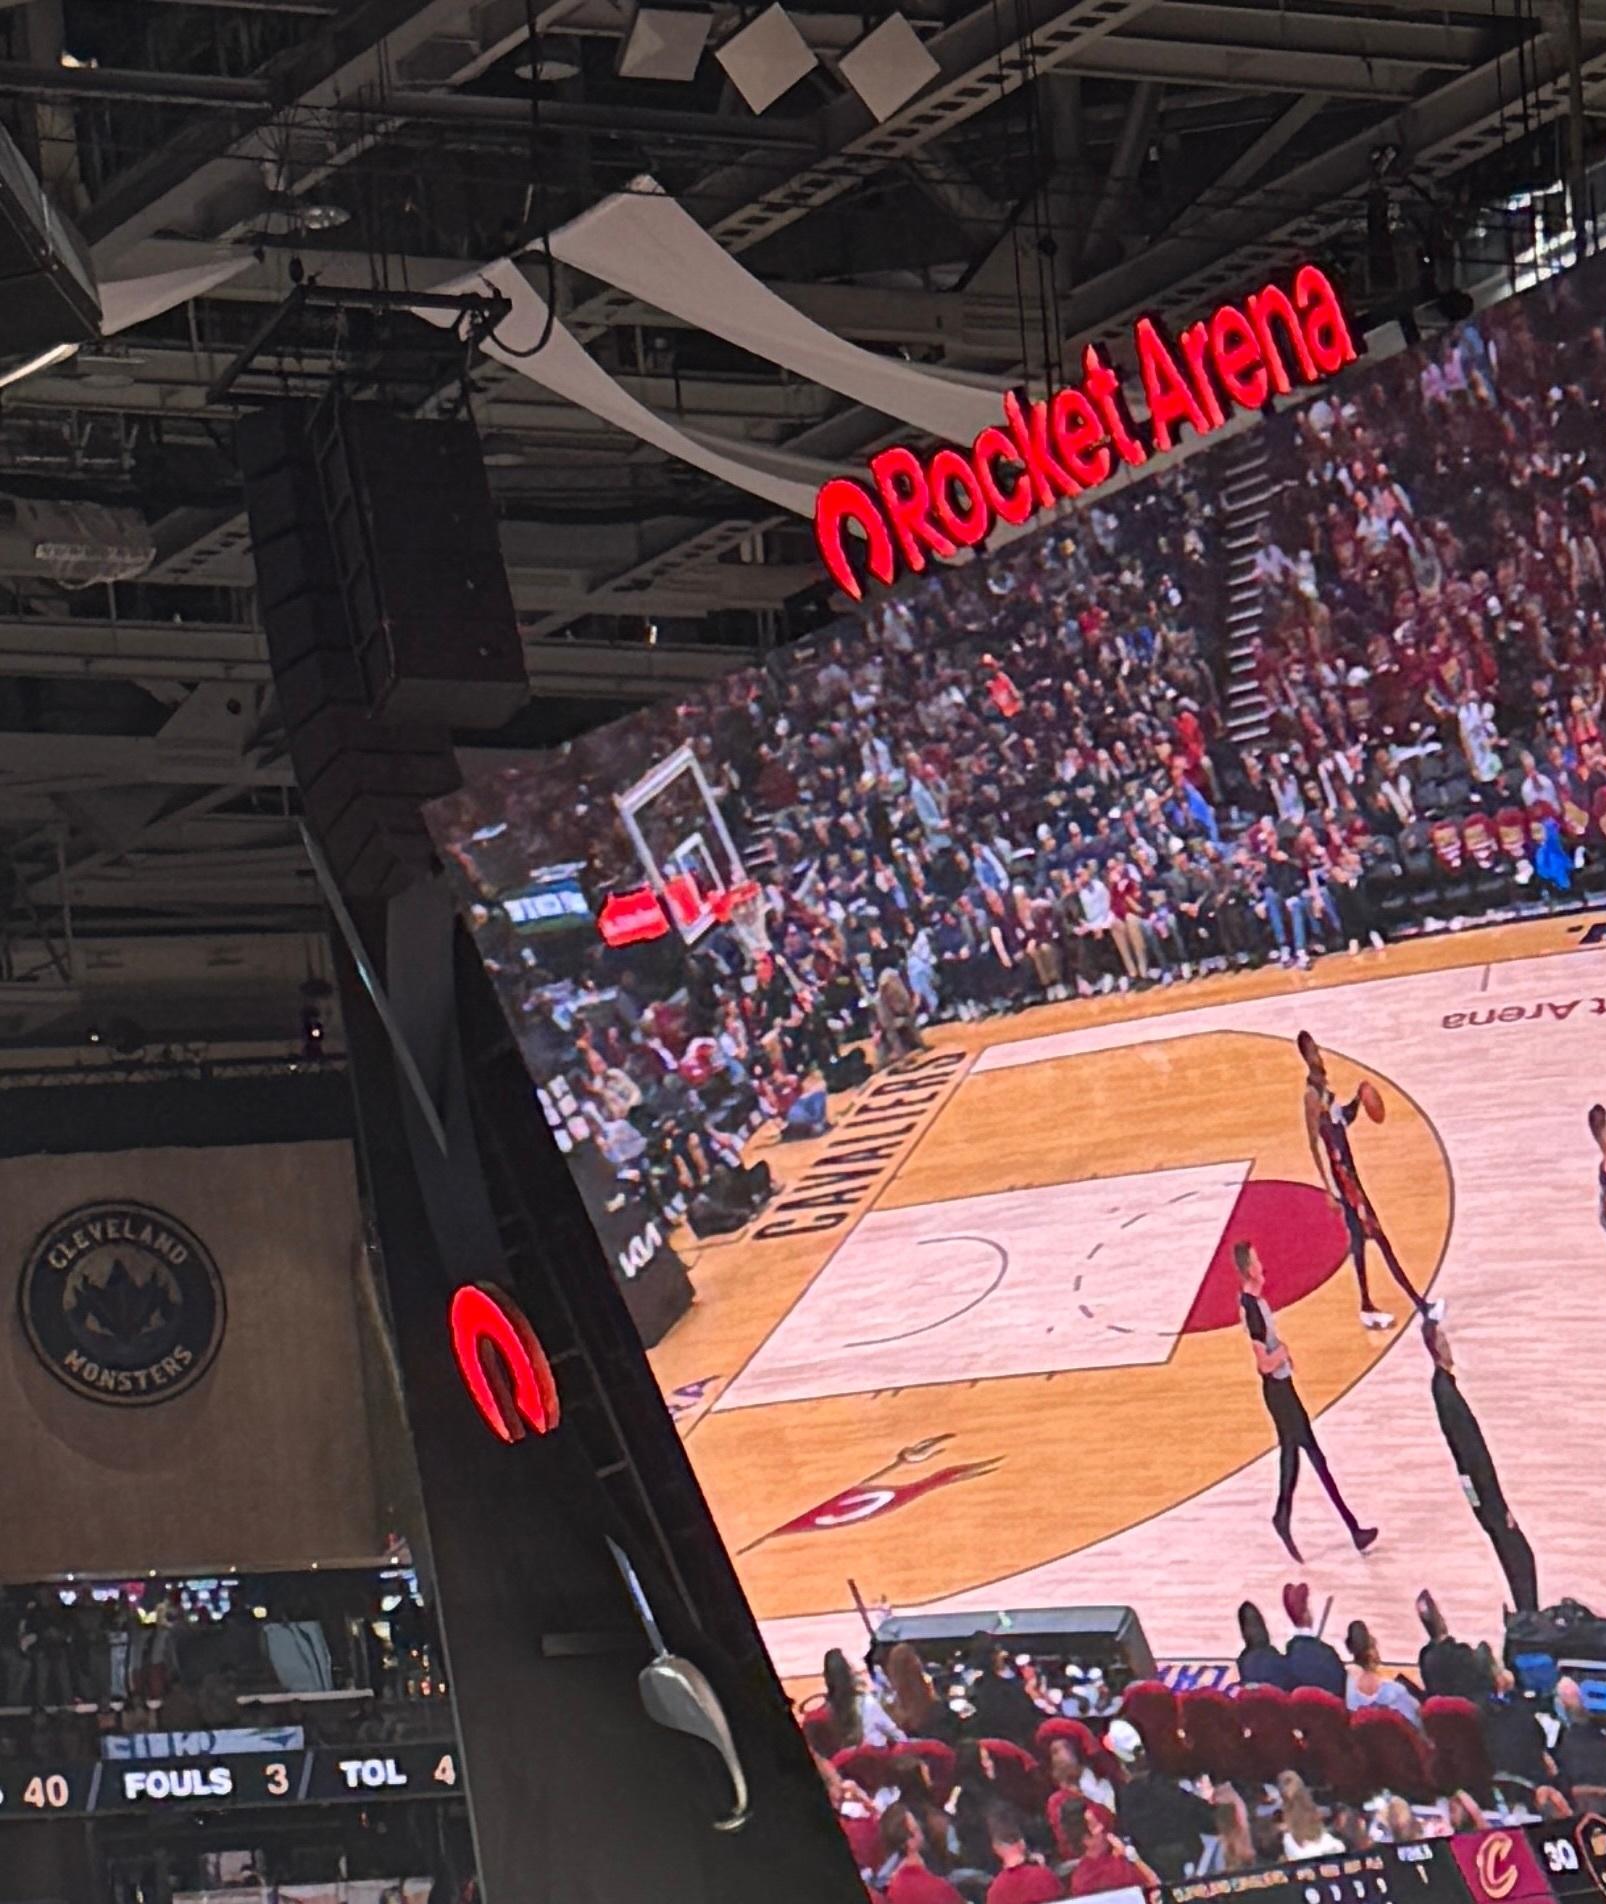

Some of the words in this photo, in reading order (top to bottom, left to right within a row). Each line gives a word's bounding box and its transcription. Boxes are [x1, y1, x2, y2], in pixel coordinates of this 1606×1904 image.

[870, 345, 1146, 572] Rocket
[1134, 264, 1358, 453] Arena
[1442, 999, 1582, 1030] Arena
[752, 1049, 967, 1243] CAVALIERS
[46, 1218, 189, 1271] CLEVELAND
[63, 1345, 194, 1392] MONSTERS
[23, 1774, 69, 1808] 40
[124, 1767, 233, 1799] FOULS
[265, 1764, 289, 1795] 3
[339, 1758, 407, 1788] TOL
[433, 1755, 456, 1785] 4
